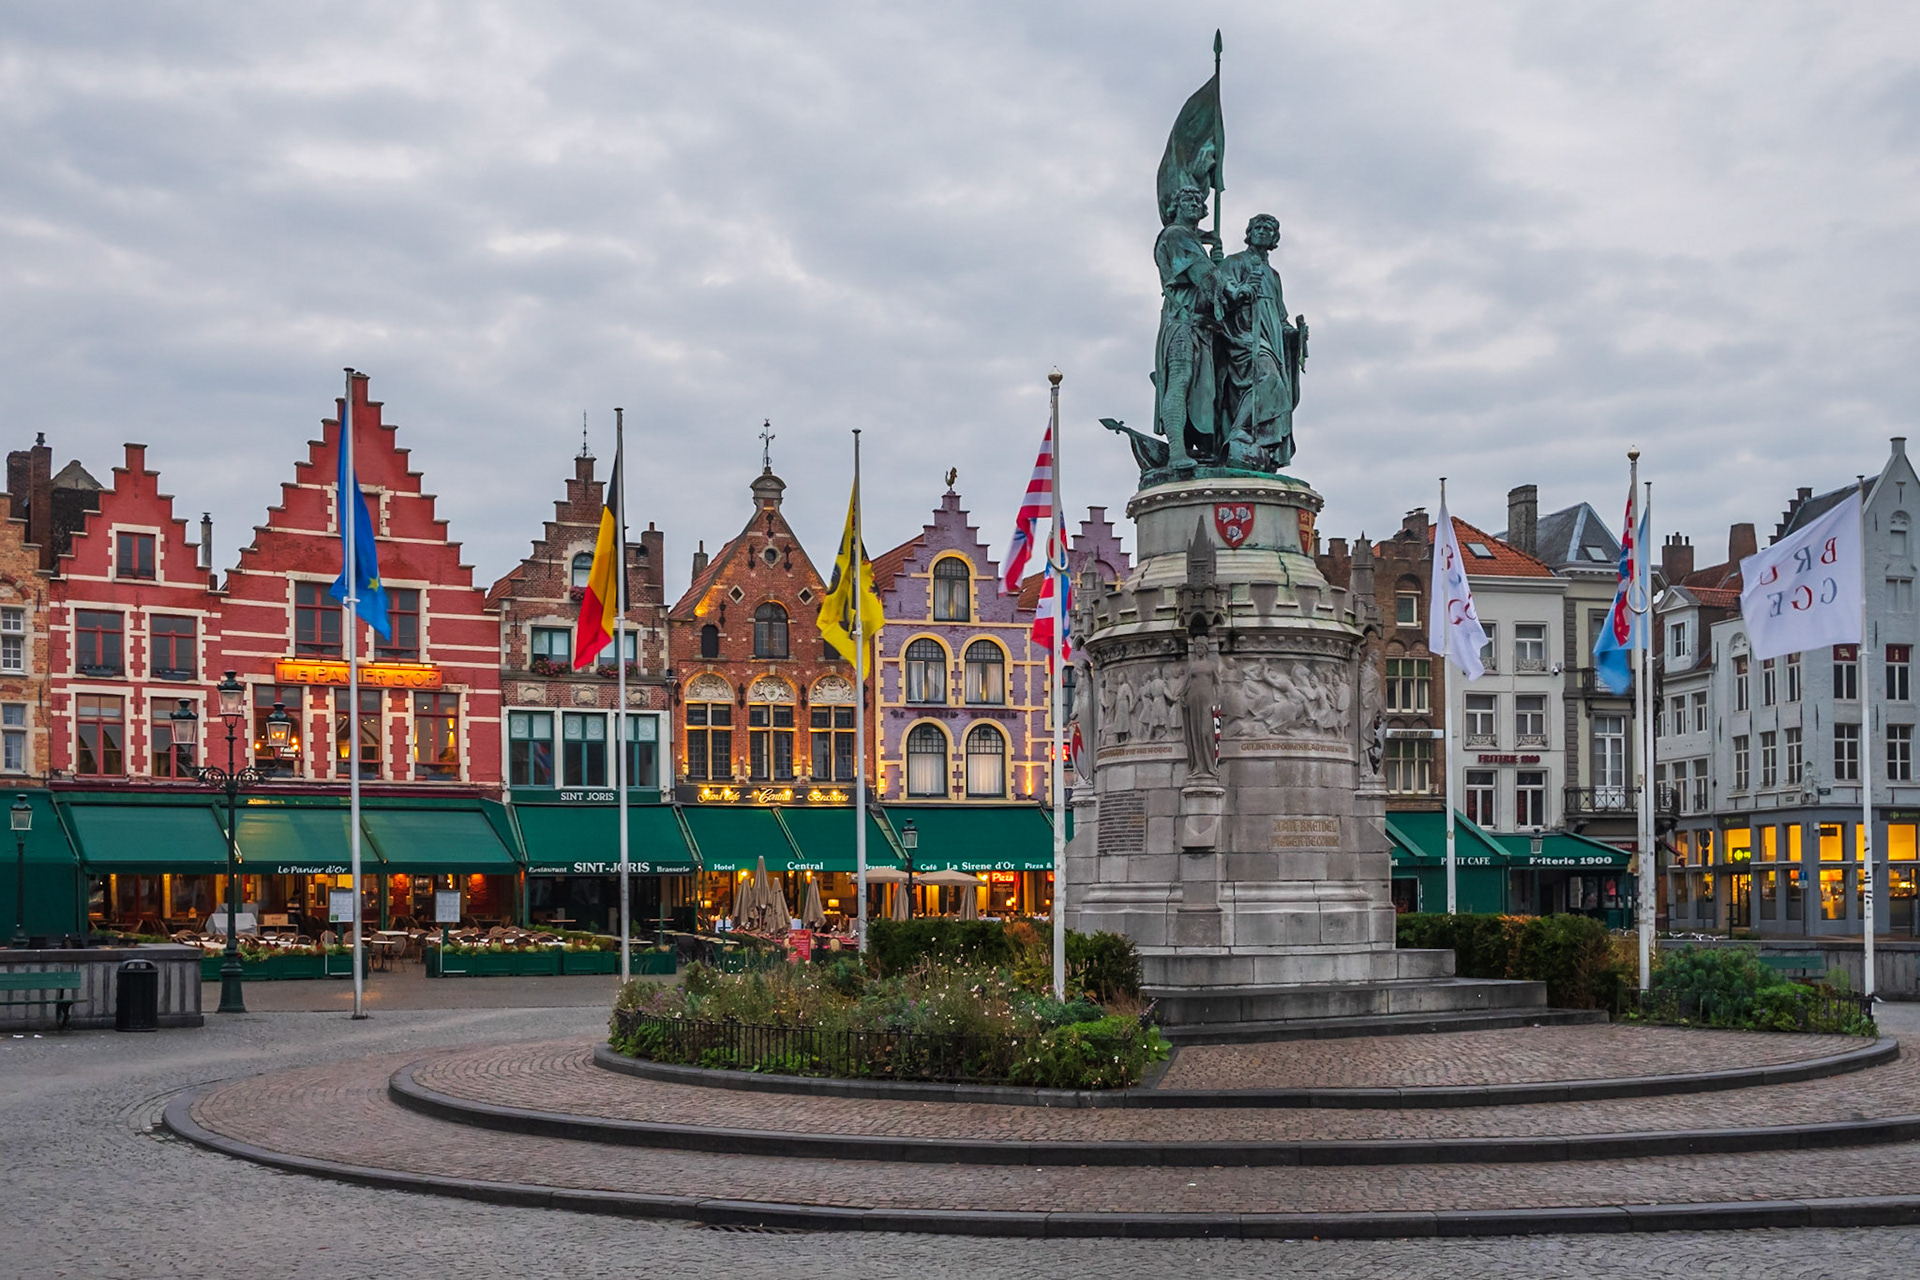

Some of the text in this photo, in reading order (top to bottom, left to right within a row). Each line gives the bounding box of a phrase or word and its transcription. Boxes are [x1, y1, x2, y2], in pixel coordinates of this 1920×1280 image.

[282, 669, 308, 682] LE
[560, 792, 614, 801] SINT JORIS
[758, 788, 792, 803] Central
[807, 790, 849, 802] Brasserie
[1440, 856, 1491, 865] PIT CAFE
[1529, 856, 1613, 866] Friterie 1900
[277, 865, 347, 874] Le Panier d'Or
[656, 865, 690, 873] Brasserie
[714, 863, 735, 871] Hotel
[787, 861, 824, 870] Central
[920, 863, 937, 871] Café
[947, 862, 958, 870] La
[995, 861, 1015, 870] d'Or
[1025, 862, 1044, 870] Pizza
[992, 872, 1014, 882] Pizza
